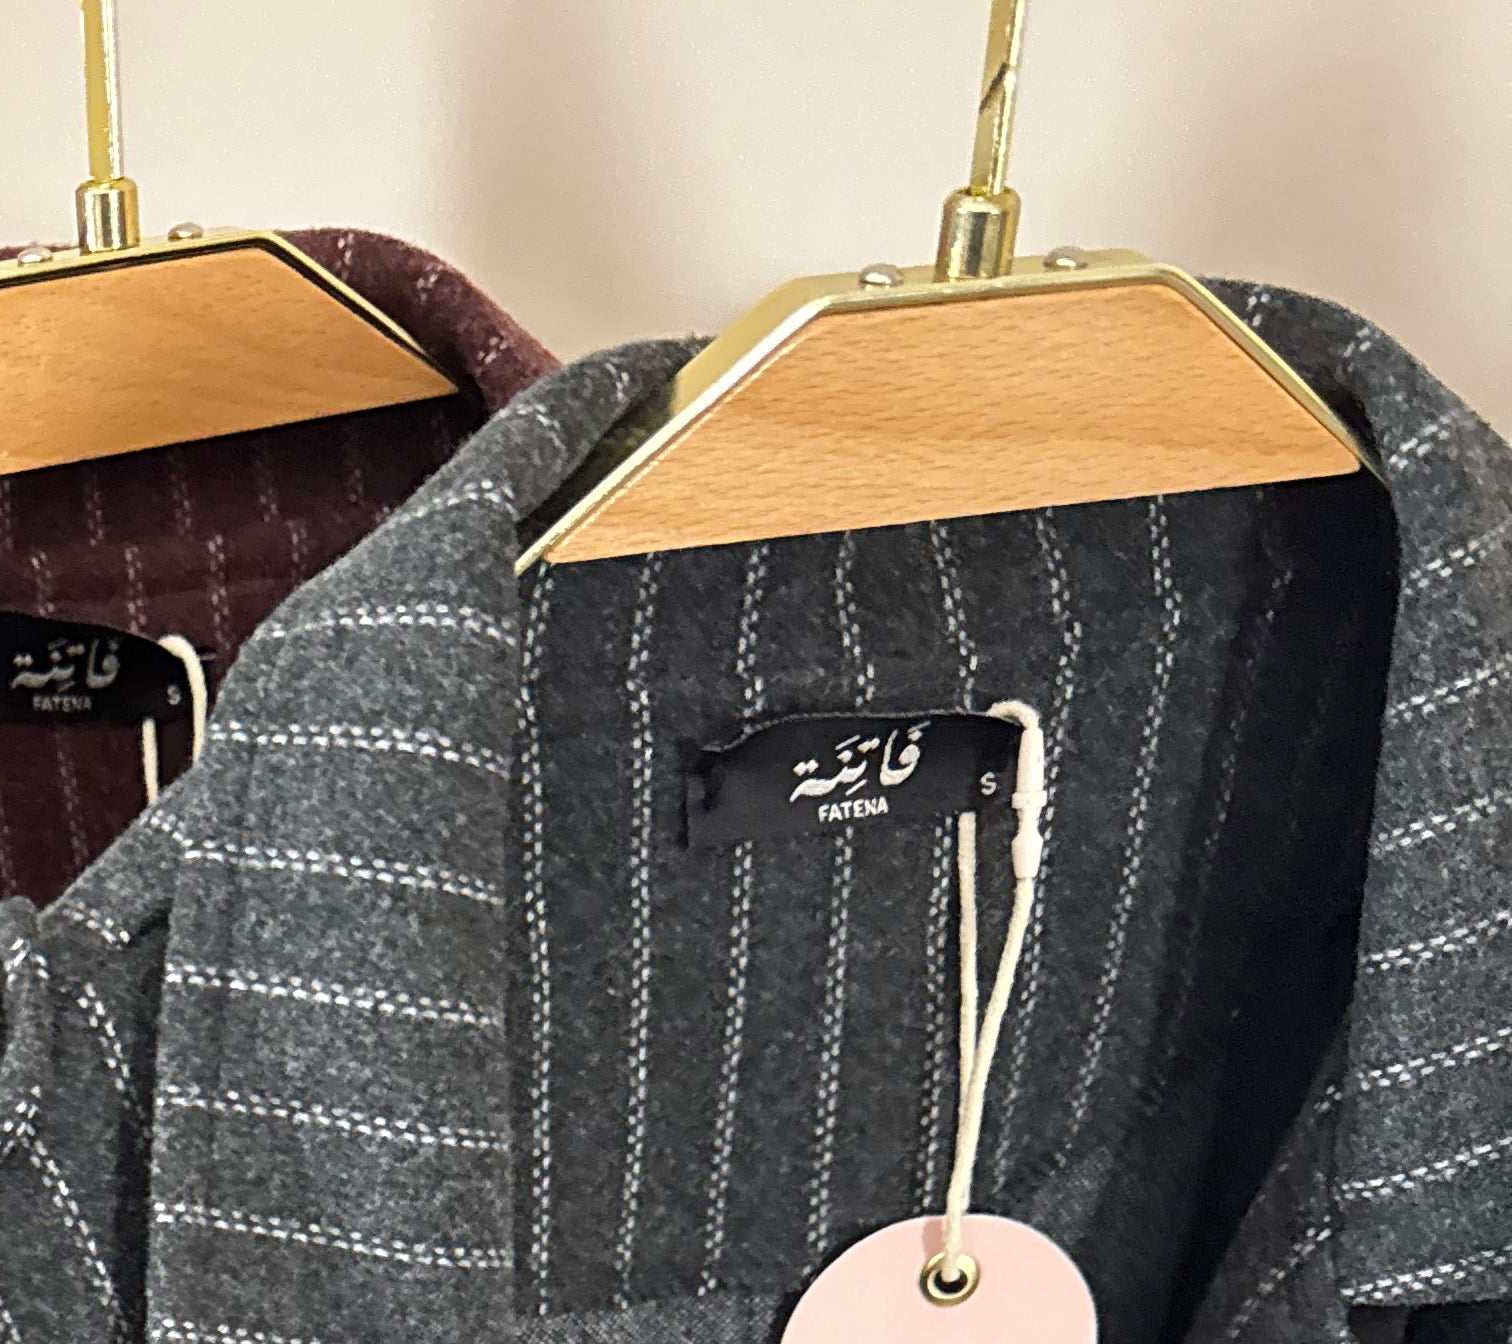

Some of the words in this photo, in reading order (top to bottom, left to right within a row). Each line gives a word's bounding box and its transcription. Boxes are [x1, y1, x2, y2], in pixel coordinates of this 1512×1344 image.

[32, 695, 92, 712] FATENA
[980, 772, 996, 796] S
[818, 797, 889, 824] FATENA
